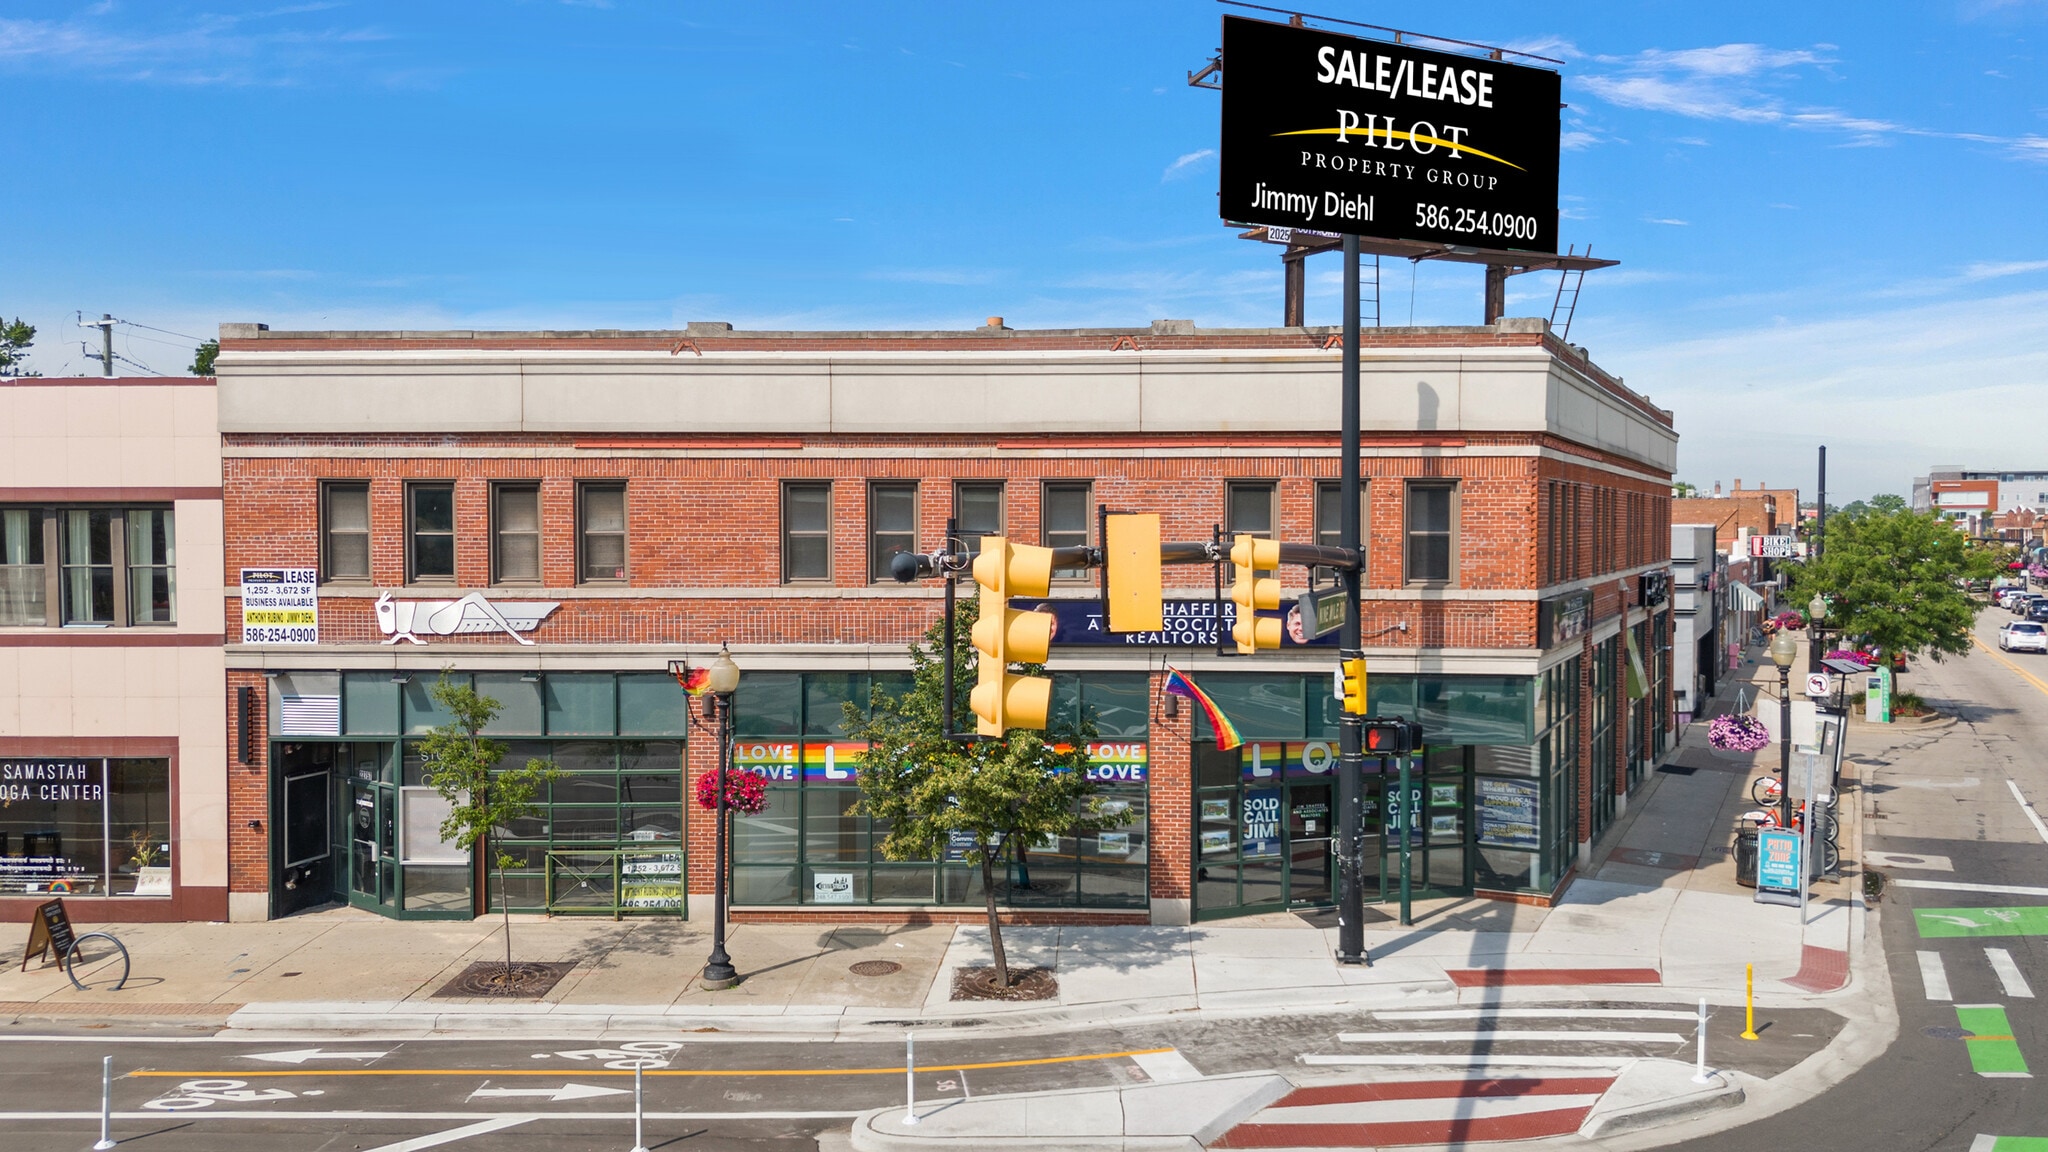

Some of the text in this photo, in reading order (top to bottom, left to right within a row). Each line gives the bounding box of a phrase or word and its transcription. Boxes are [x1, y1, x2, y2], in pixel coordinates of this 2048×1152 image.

[1317, 45, 1494, 109] SALE/LEASE
[1336, 109, 1469, 159] PILOT
[1301, 151, 1498, 191] PROPERTY GROUP
[1251, 182, 1538, 240] Jimmy Diehl 586.254.0900
[1269, 227, 1290, 241] 2025
[1763, 537, 1786, 546] BIKE
[1762, 547, 1786, 556] SHOP
[285, 571, 315, 583] LEASE
[246, 586, 269, 595] 1,252
[275, 586, 299, 595] 3,672
[300, 586, 311, 594] SF
[245, 598, 314, 607] BUSINESS AVAILABLE
[1162, 602, 1234, 616] HAFFR
[246, 628, 316, 642] 586-254-0900
[1125, 631, 1218, 644] REALTORS
[738, 744, 794, 760] LOVE
[1086, 744, 1141, 760] LOVE
[3, 764, 86, 780] SAMASTAH
[738, 764, 1142, 780] OVE LOVE
[0, 784, 102, 800] OGA CENTER
[1243, 798, 1279, 812] SOLD
[1243, 810, 1279, 824] CALL
[1243, 822, 1274, 839] JIM
[1767, 838, 1793, 851] PATIO
[663, 854, 682, 862] LEA
[1768, 851, 1791, 862] ZONE
